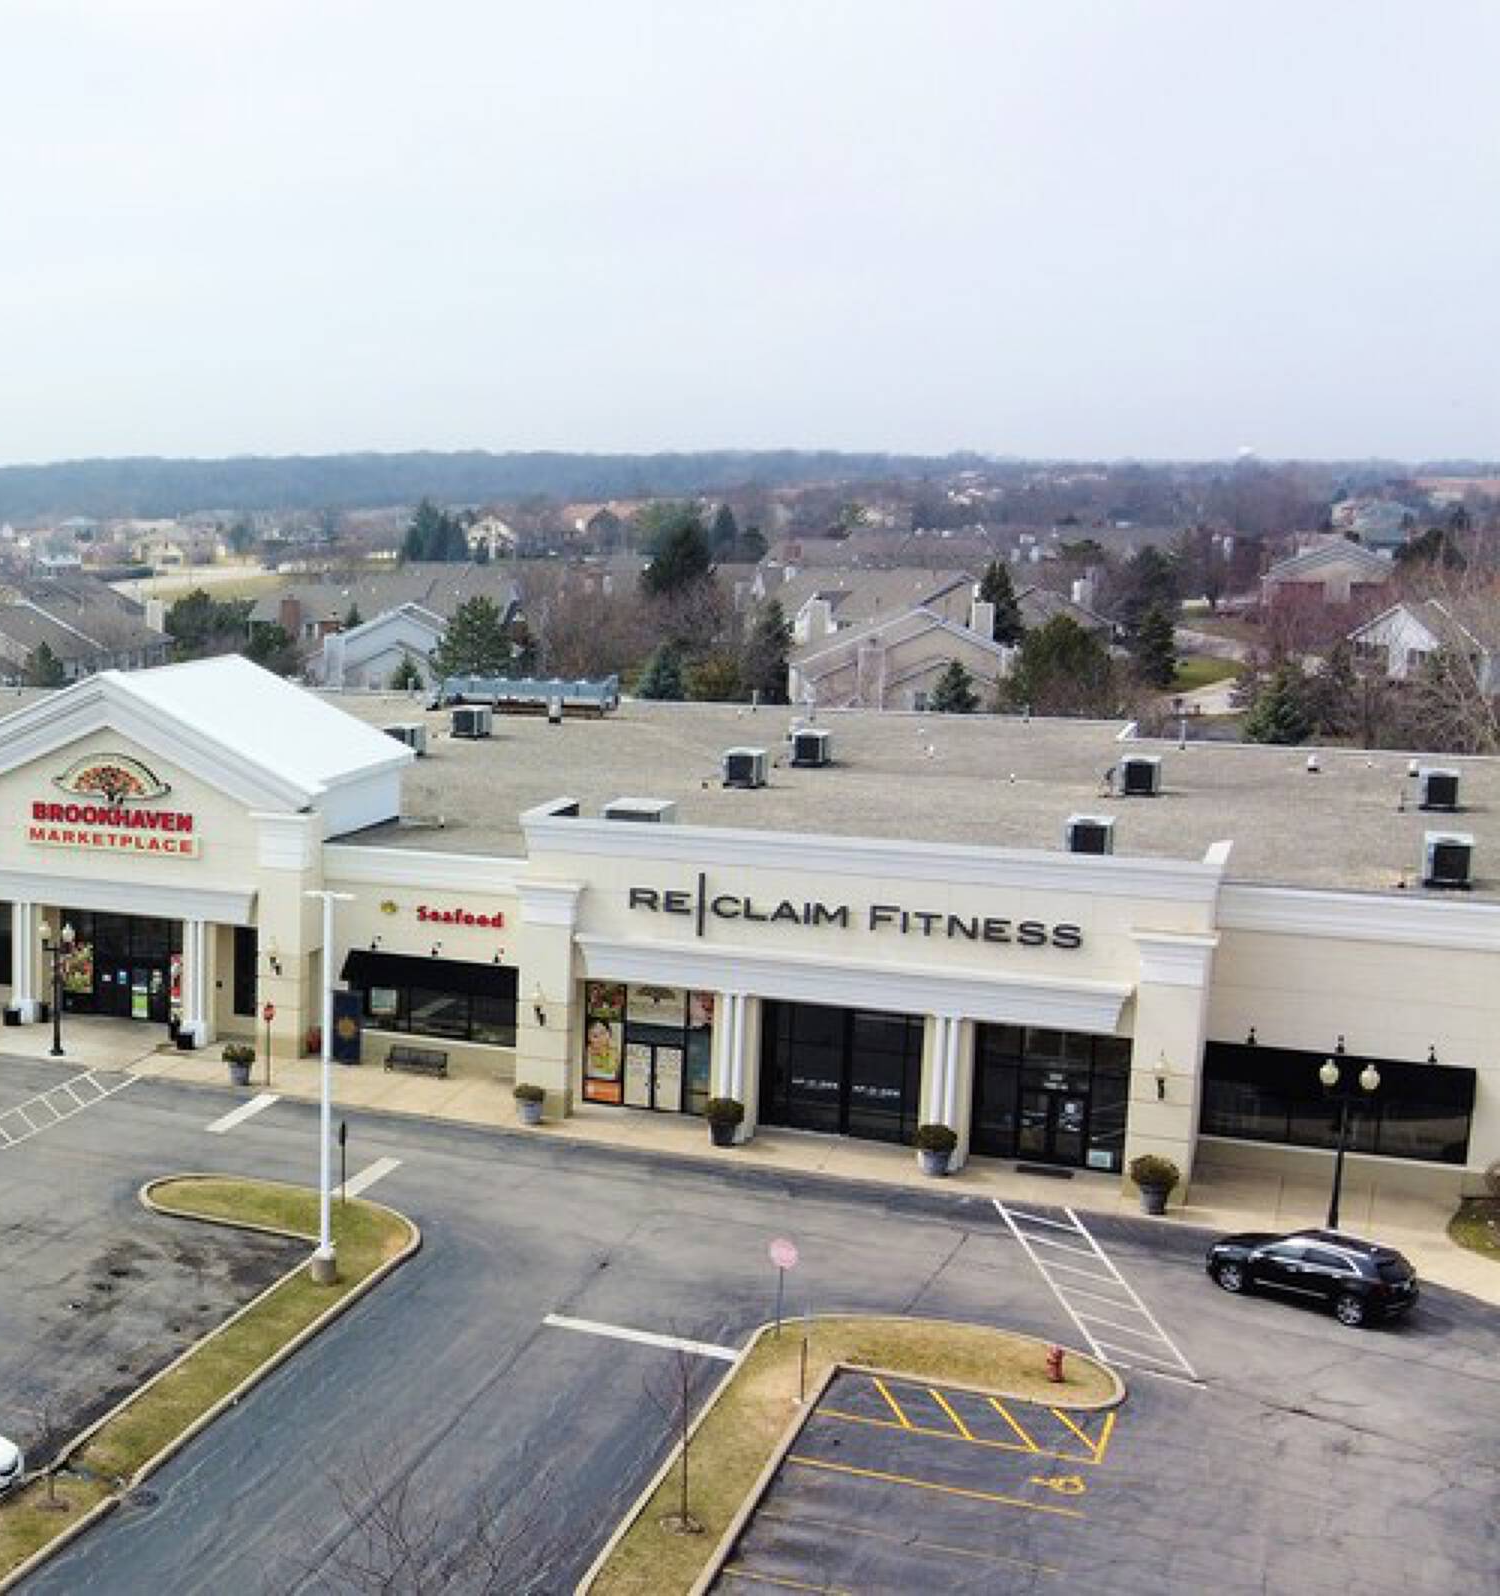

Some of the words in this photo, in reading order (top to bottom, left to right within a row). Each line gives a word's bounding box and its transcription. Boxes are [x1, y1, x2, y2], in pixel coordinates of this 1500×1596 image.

[32, 801, 193, 833] BROOKHAVEN
[29, 827, 193, 853] MARKETPLACE
[417, 905, 504, 928] Seafood
